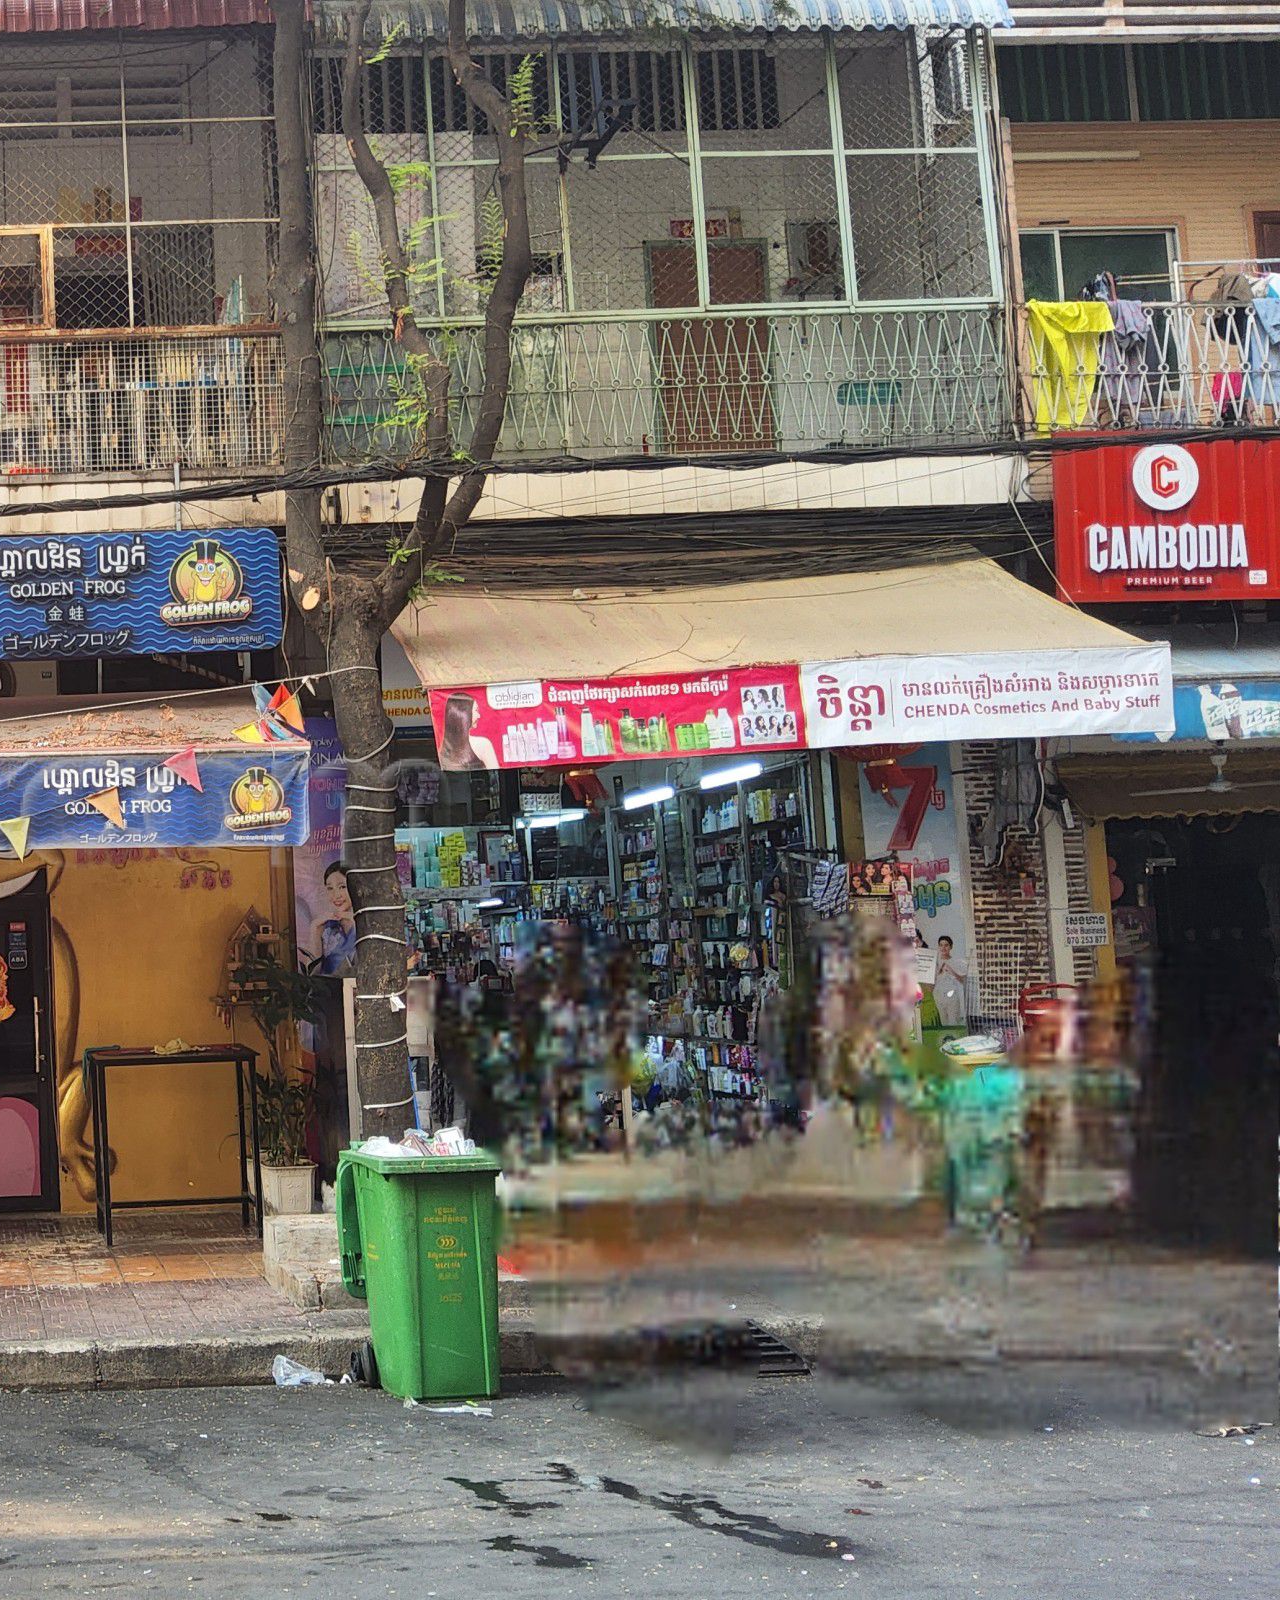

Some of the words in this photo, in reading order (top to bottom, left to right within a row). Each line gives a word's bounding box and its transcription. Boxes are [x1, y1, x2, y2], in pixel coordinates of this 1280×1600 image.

[1089, 523, 1249, 573] CAMBODIA
[10, 581, 74, 598] GOLDEN
[84, 580, 126, 596] FROG
[1127, 577, 1179, 585] PREMIUM
[1184, 576, 1213, 584] BEER
[47, 605, 85, 622] 金蛙
[162, 604, 213, 619] GOLDEN
[215, 599, 250, 615] FROG
[4, 629, 130, 650] ゴールデンフロッグ
[904, 705, 970, 719] CHENDA
[974, 702, 1046, 715] Cosmetics
[1052, 700, 1079, 712] And
[1083, 697, 1119, 713] Baby
[1125, 695, 1160, 708] Stuff
[131, 799, 172, 814] FROG
[226, 810, 263, 826] GOLDEN
[264, 807, 290, 823] FROG
